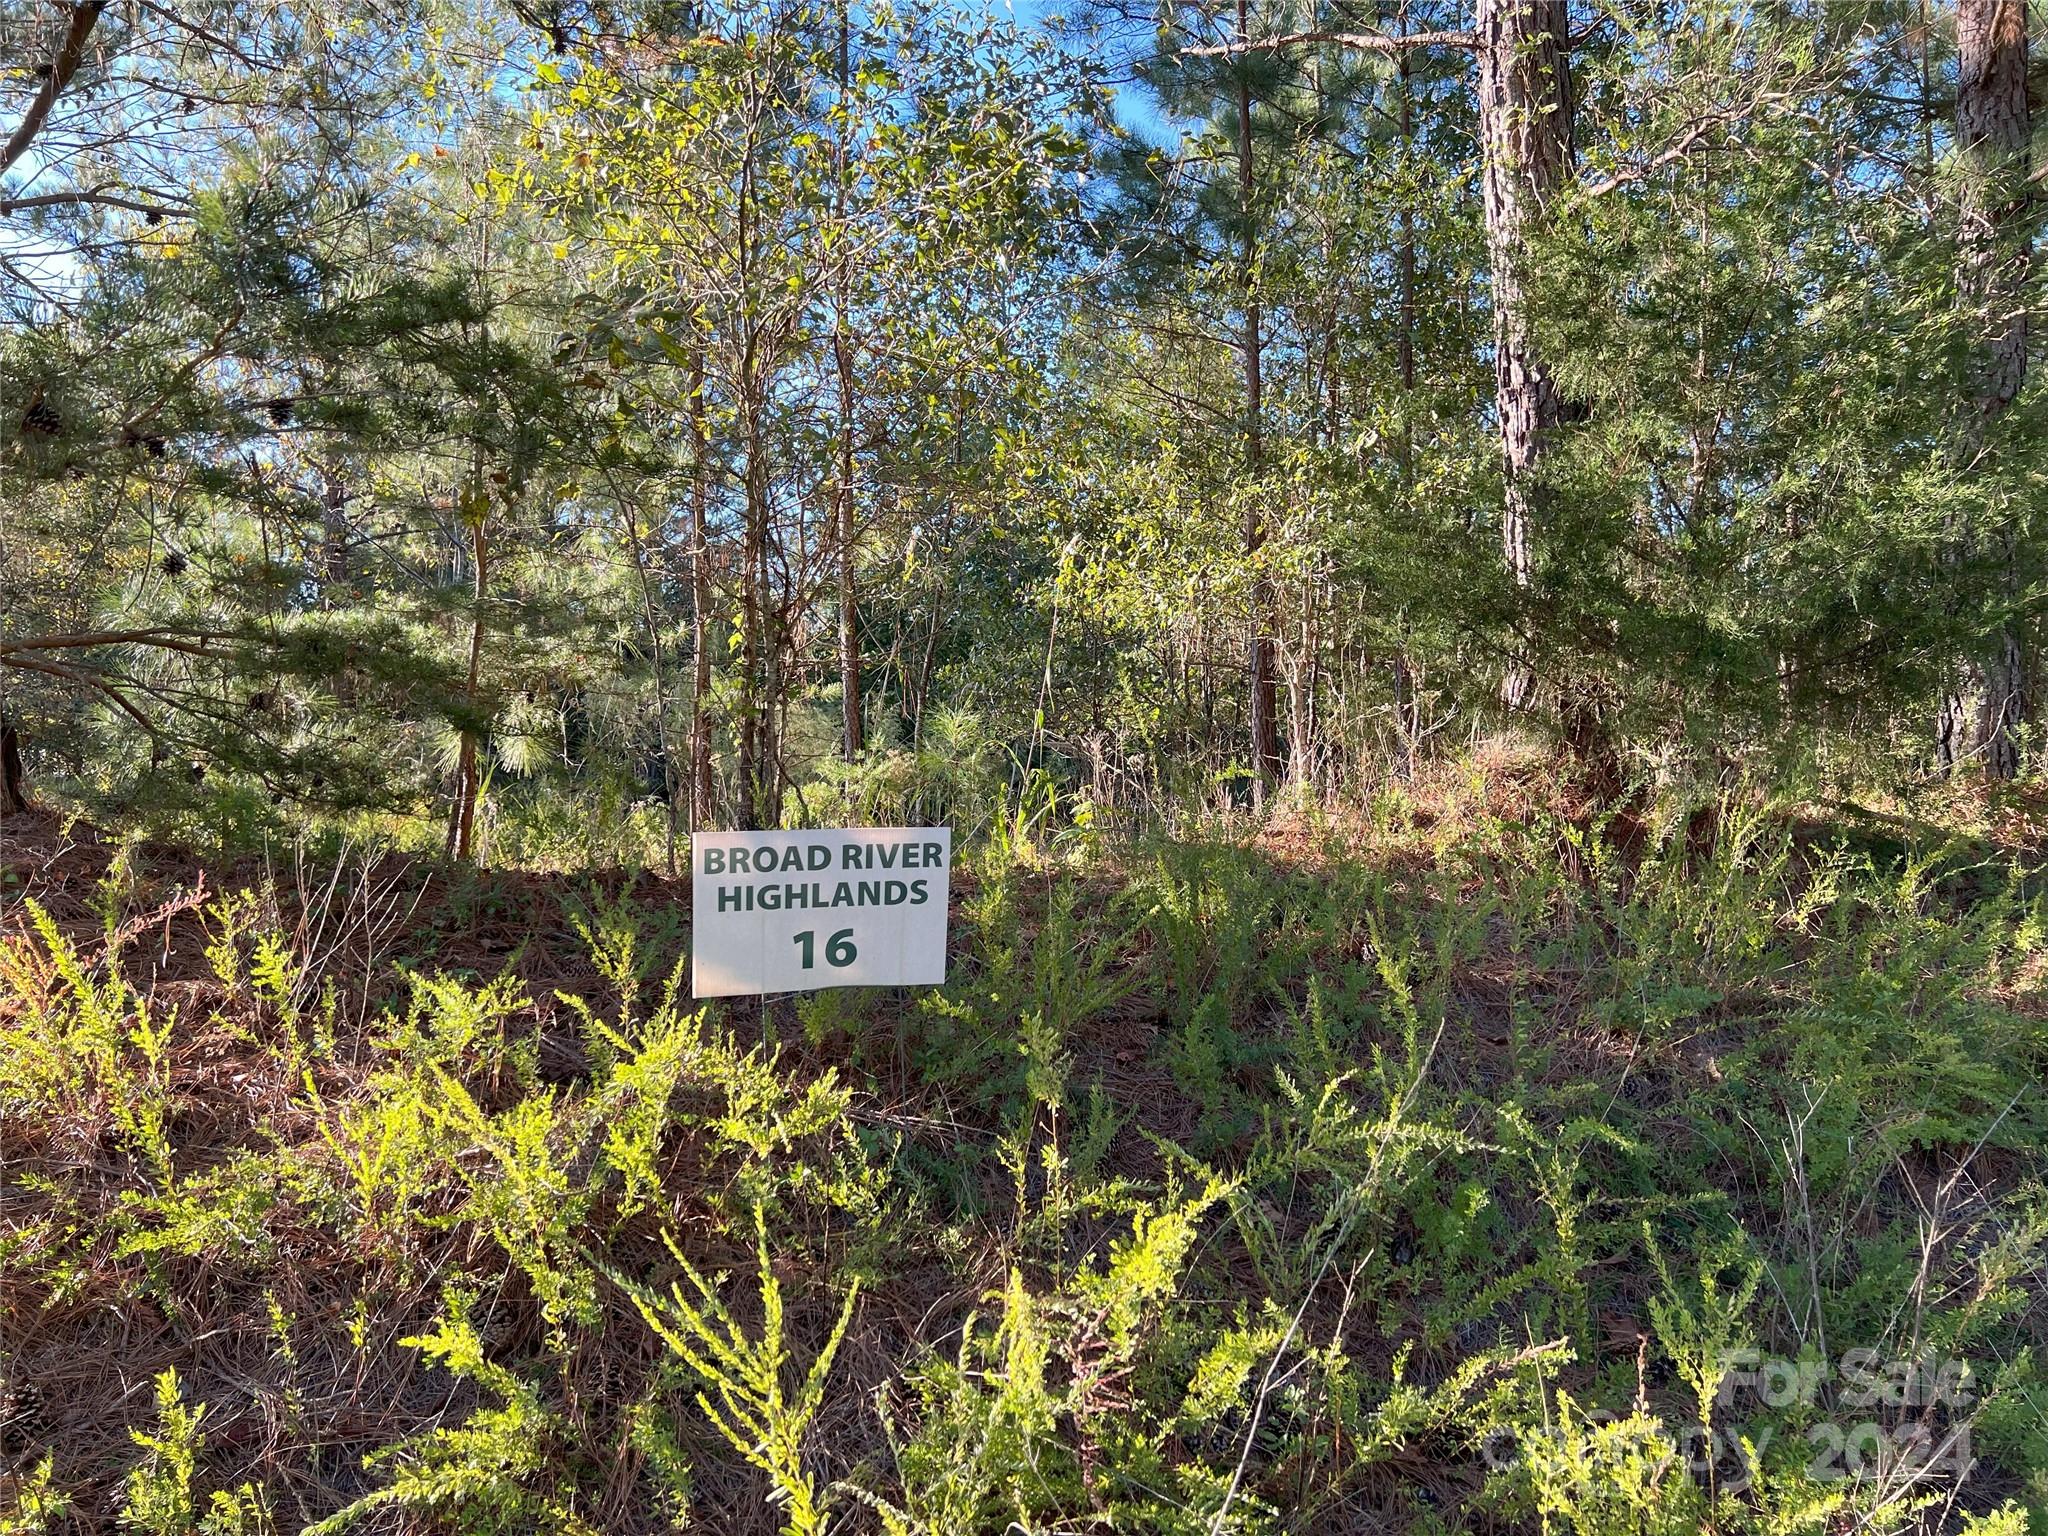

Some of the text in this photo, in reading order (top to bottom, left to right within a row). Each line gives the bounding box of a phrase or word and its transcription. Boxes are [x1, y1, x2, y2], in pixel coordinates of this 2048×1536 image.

[703, 842, 943, 875] BROAD RIVER
[717, 879, 929, 912] HIGHLANDS
[793, 928, 858, 970] 16
